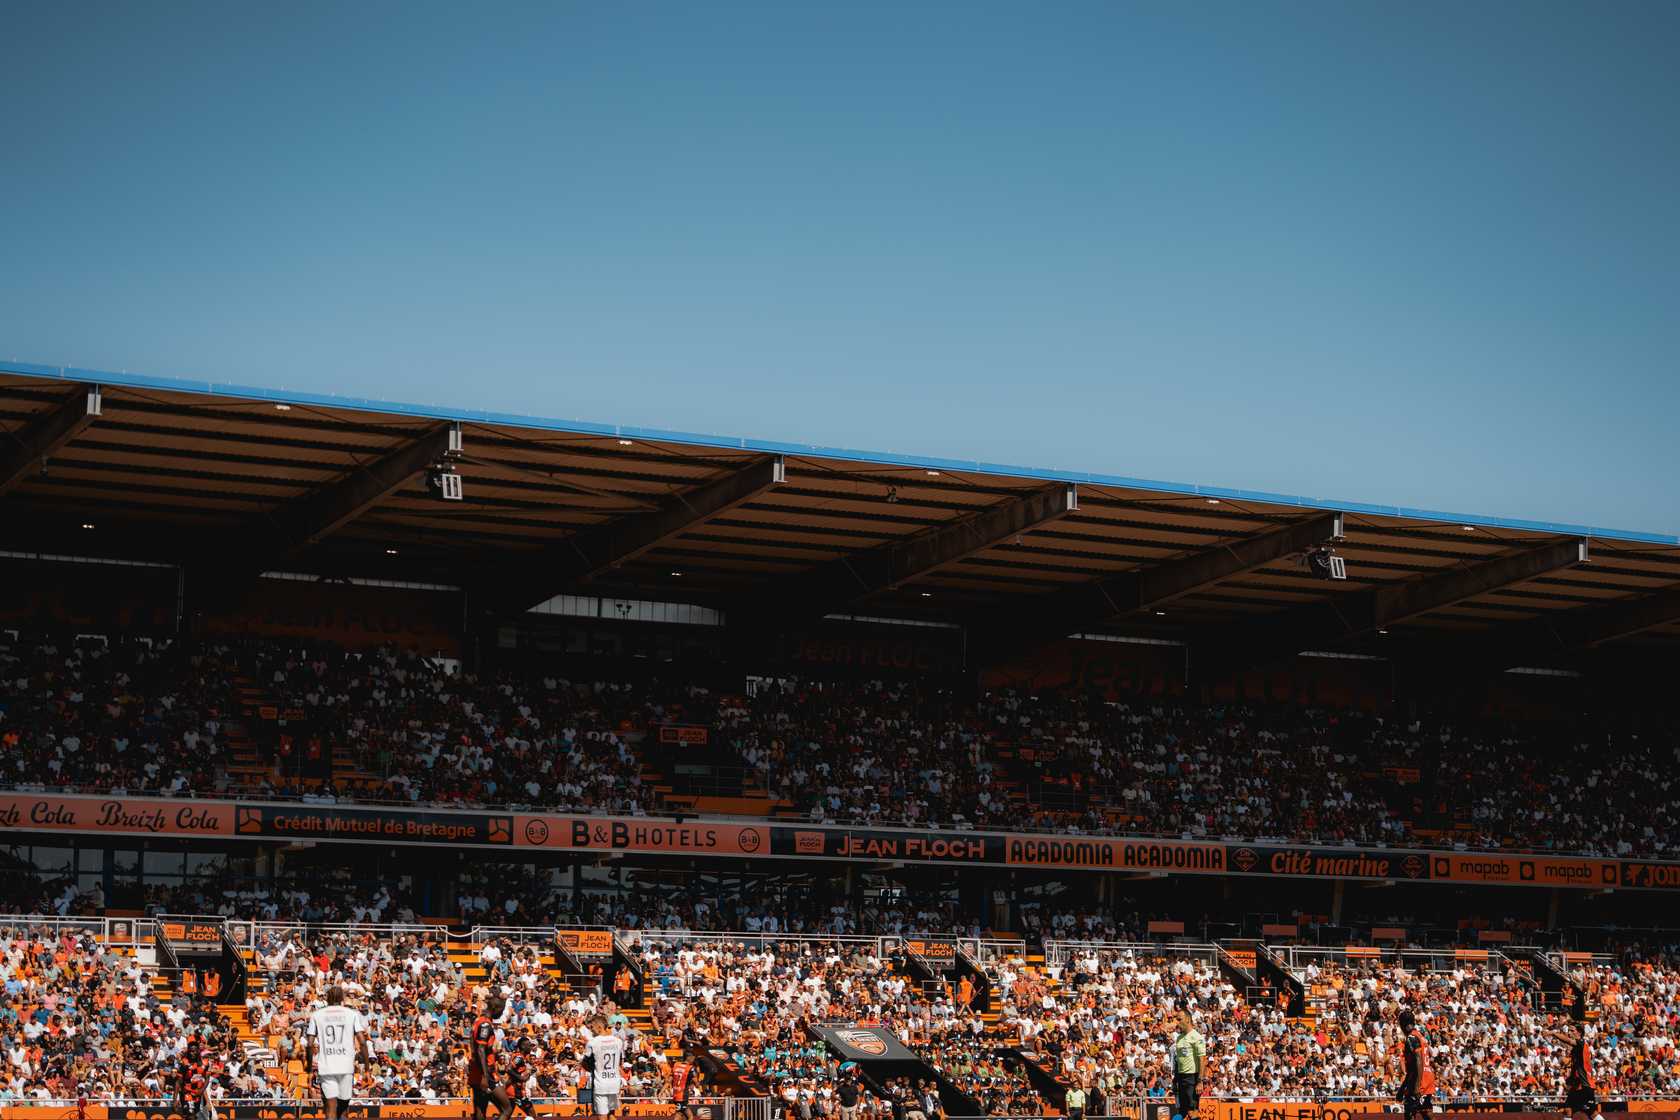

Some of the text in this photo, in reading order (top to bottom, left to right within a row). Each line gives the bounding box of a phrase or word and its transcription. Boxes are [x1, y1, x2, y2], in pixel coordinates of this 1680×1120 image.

[31, 801, 76, 825] Cola
[96, 801, 219, 832] Breizh Cola
[273, 815, 477, 839] Crédit Mutuel de Bretagne
[572, 820, 717, 848] B&B HOTELS
[836, 834, 898, 857] JEAN
[1010, 840, 1113, 865] ACADOMIA
[1124, 844, 1223, 869] ACADOMIA
[1270, 849, 1312, 874] Cité
[1315, 851, 1391, 877] marine
[1459, 859, 1510, 880] mapab
[1544, 863, 1593, 884] mapab
[191, 924, 217, 932] JEAN
[584, 934, 607, 942] JEAN
[325, 1025, 345, 1044] 97
[603, 1053, 616, 1070] 21
